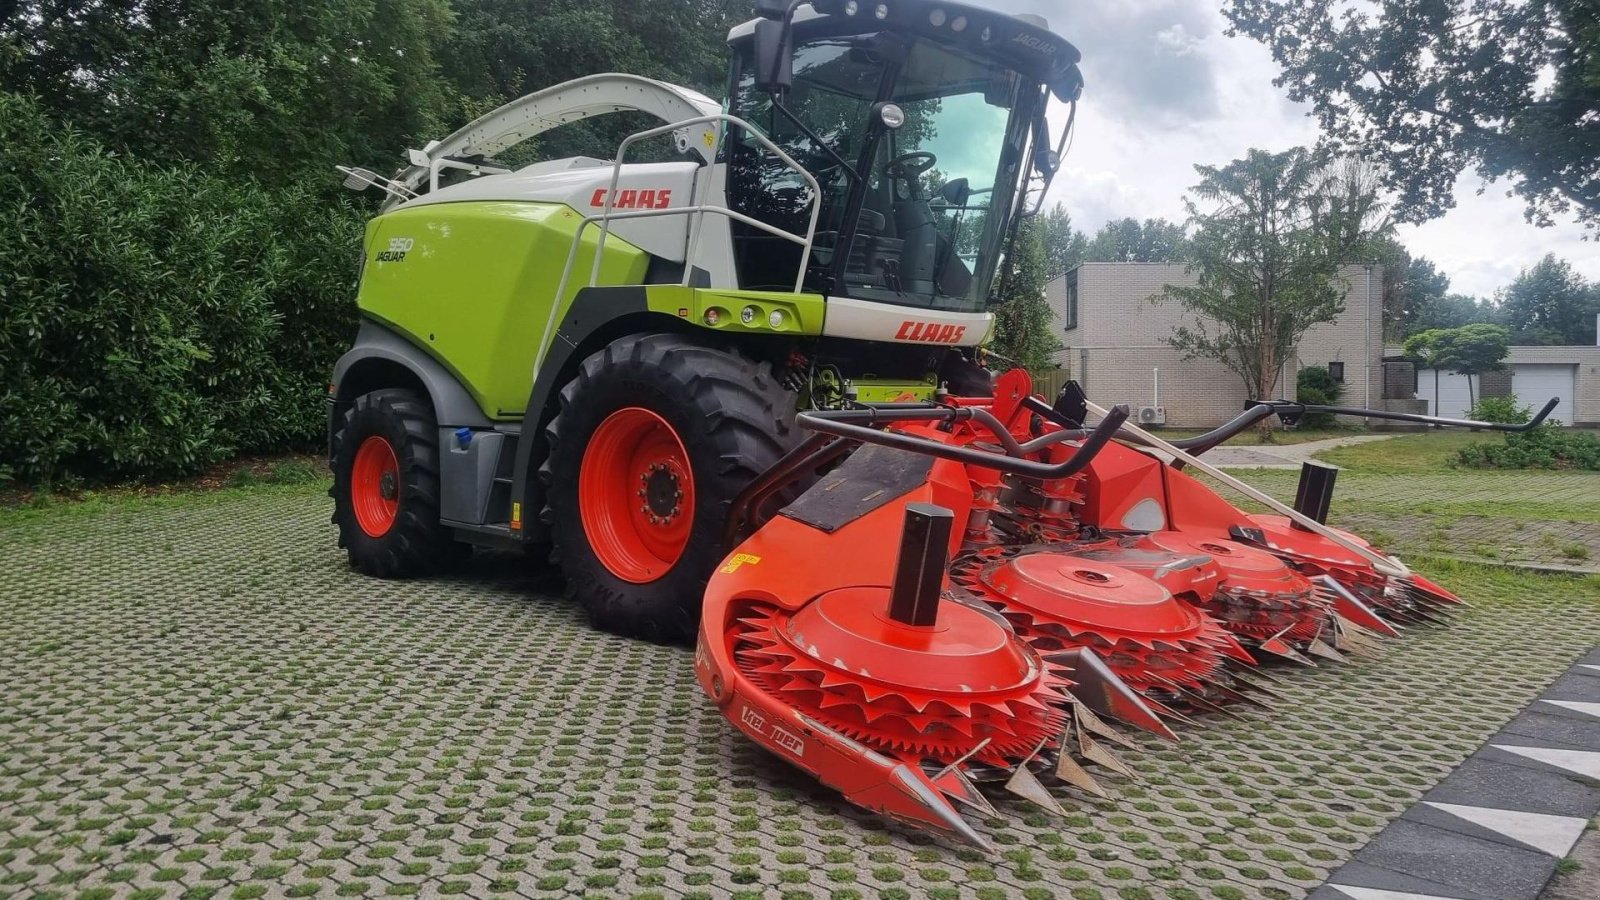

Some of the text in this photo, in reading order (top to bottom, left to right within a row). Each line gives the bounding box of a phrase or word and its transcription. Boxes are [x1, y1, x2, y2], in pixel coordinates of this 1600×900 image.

[1012, 32, 1057, 56] JAGUAR
[375, 251, 406, 262] JAGUAR
[895, 321, 967, 344] CLAAS
[742, 706, 804, 756] Keper
